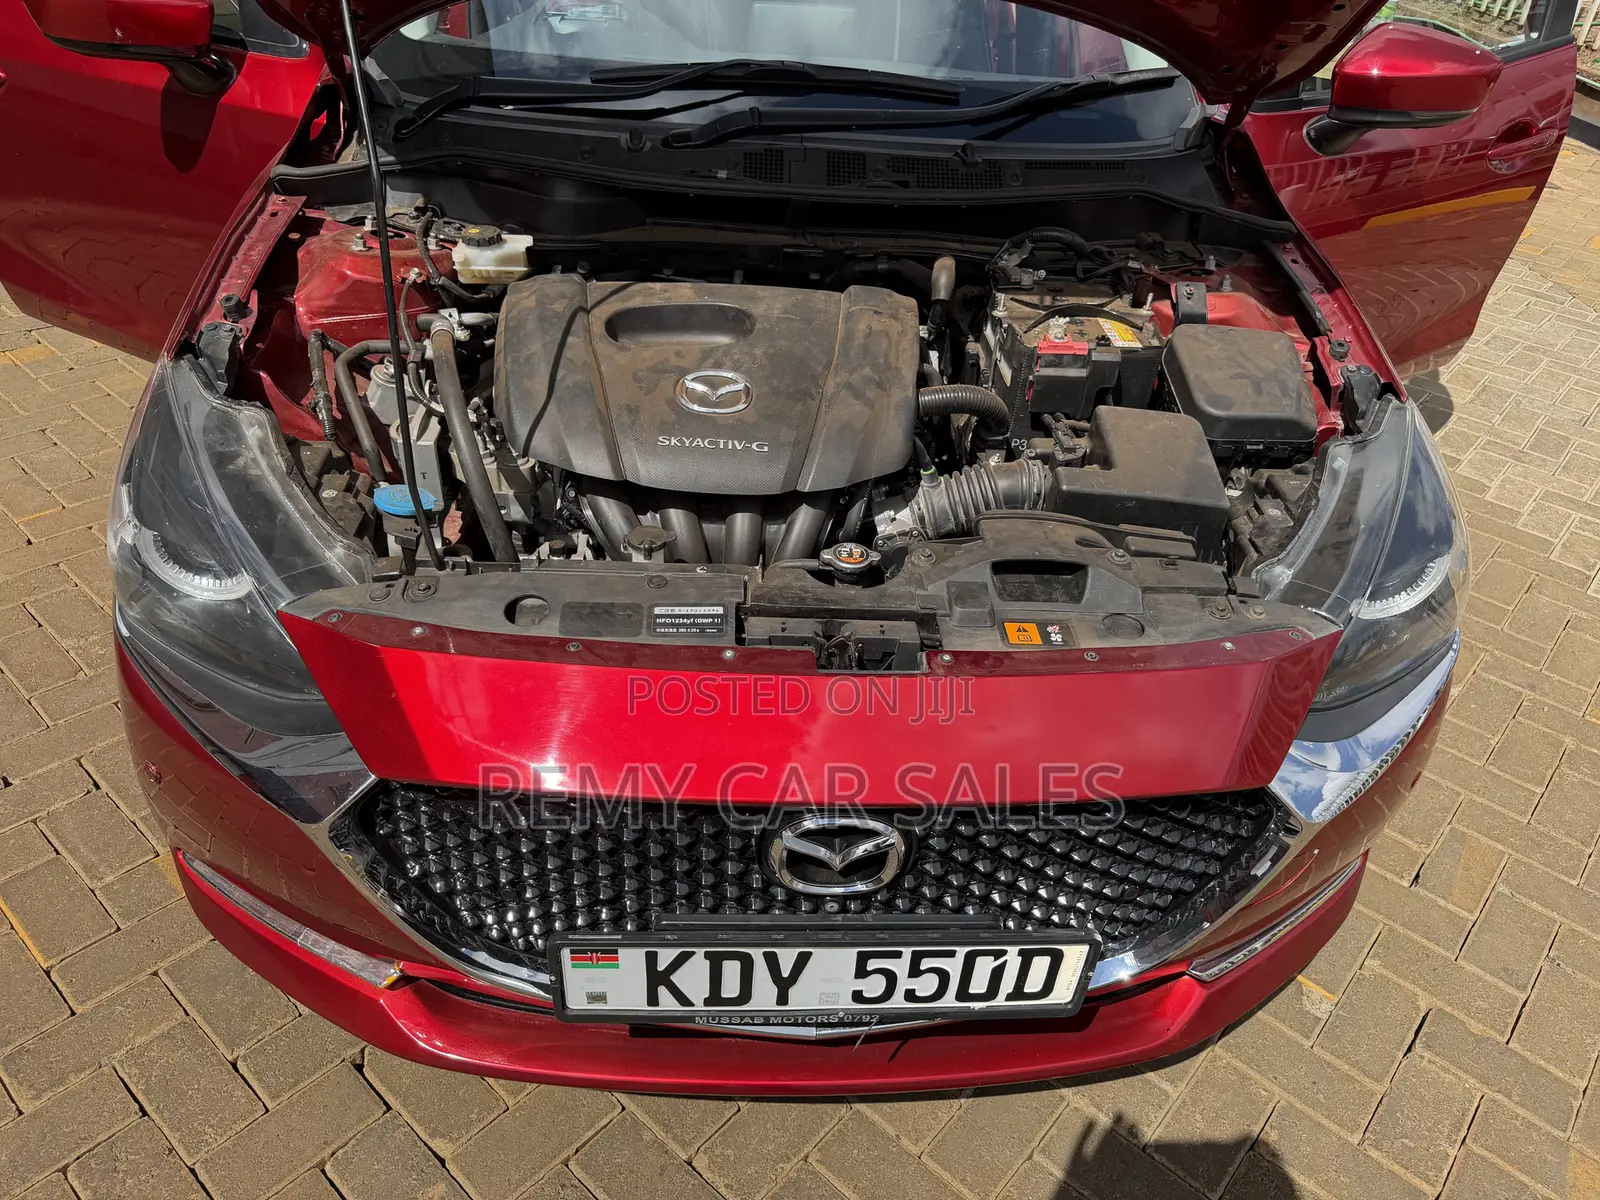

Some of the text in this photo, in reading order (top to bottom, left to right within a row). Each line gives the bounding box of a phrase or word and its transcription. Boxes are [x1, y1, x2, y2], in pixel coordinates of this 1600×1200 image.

[657, 435, 769, 452] SKYACTIV-G
[644, 950, 813, 1007] KDY
[850, 947, 1064, 1005] 550D
[695, 1016, 765, 1024] MUSSAB
[769, 1014, 839, 1024] MOTORS
